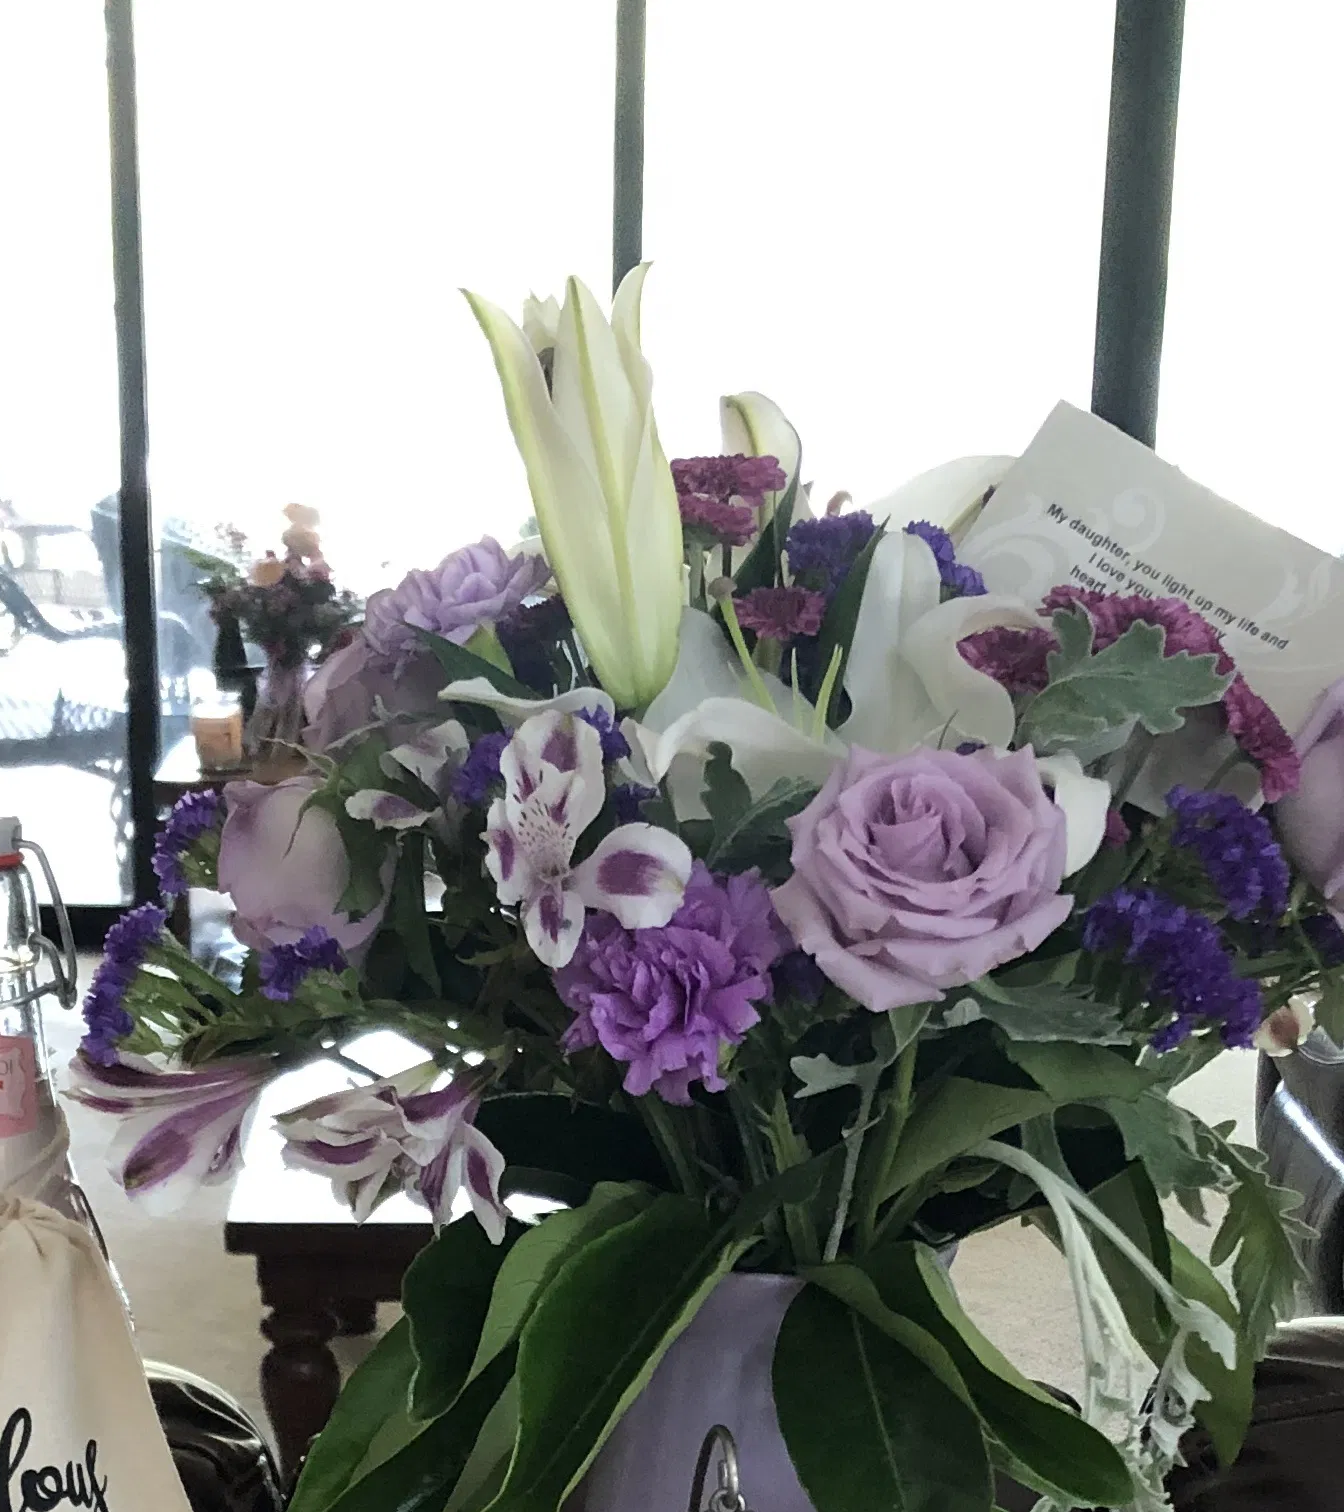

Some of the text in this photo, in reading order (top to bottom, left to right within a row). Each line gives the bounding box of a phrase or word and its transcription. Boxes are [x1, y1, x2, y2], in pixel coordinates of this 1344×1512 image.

[1047, 503, 1290, 650] My daughter, you light up my life and
[1088, 552, 1097, 564] I
[1096, 557, 1126, 583] love
[1125, 579, 1153, 599] you
